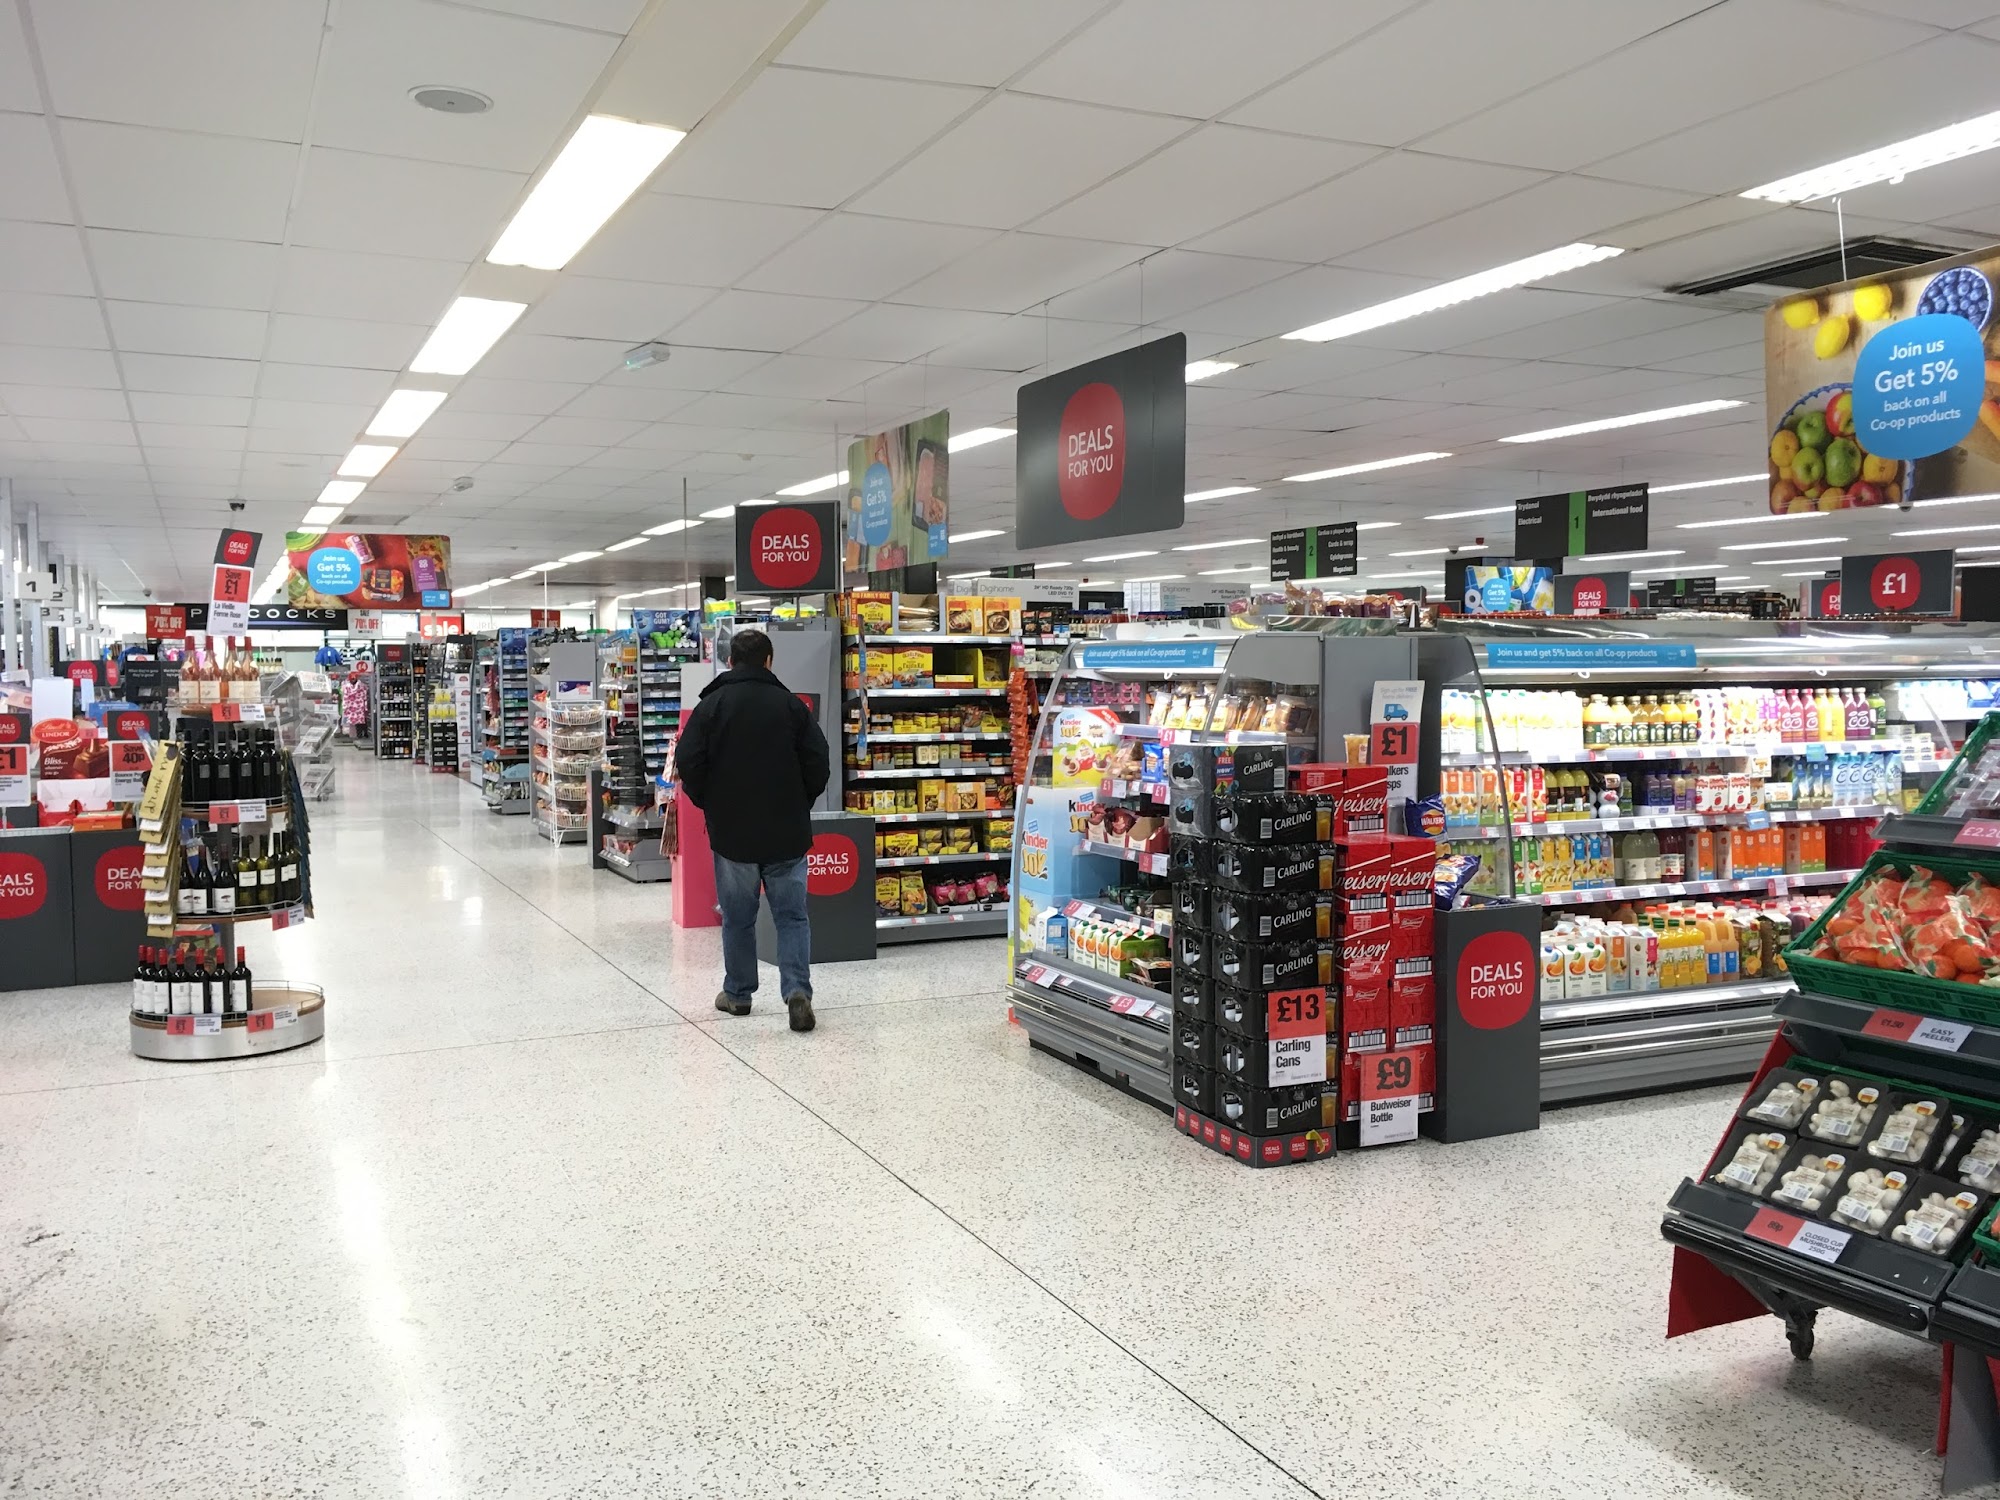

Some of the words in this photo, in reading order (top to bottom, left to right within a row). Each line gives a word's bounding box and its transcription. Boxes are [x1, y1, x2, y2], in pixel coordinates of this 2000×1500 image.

[1889, 343, 1922, 361] Join
[1927, 340, 1945, 354] us
[1875, 371, 1915, 393] Get
[1921, 359, 1959, 386] 5%
[1884, 397, 1912, 413] back
[1914, 398, 1930, 407] on
[1932, 391, 1947, 405] all
[1871, 417, 1905, 431] Co-op
[1908, 408, 1961, 427] products
[1068, 425, 1114, 458] DEALS
[1068, 460, 1088, 480] FOR
[1090, 454, 1114, 474] YOU
[867, 495, 877, 507] Get
[878, 492, 887, 503] 5%
[1518, 502, 1540, 511] Trydanol
[1592, 506, 1629, 518] International
[1629, 505, 1644, 514] food
[1518, 517, 1543, 526] Electrical
[1575, 516, 1580, 529] 1
[230, 541, 249, 550] DEALS
[762, 534, 810, 551] DEALS
[762, 552, 784, 563] FOR
[786, 551, 810, 563] YOU
[1309, 546, 1314, 557] 2
[317, 563, 335, 572] Get
[336, 563, 351, 572] 5%
[1333, 566, 1354, 574] Magazines
[225, 569, 242, 580] Save
[26, 581, 37, 593] 1
[225, 580, 238, 596] £1
[980, 585, 1015, 594] Digihome
[1162, 585, 1191, 593] Digihome
[1882, 573, 1907, 595] £1
[1578, 592, 1602, 600] DEALS
[42, 607, 51, 617] 3
[655, 612, 668, 620] GOT
[154, 616, 169, 628] 70%
[170, 616, 183, 629] OFF
[355, 618, 367, 629] 70%
[368, 618, 380, 630] OFF
[424, 621, 459, 637] sale
[1087, 650, 1095, 658] Join
[1102, 649, 1110, 657] and
[1118, 649, 1126, 657] 5%
[1126, 649, 1136, 657] back
[1150, 648, 1165, 658] Co-op
[1165, 648, 1187, 658] products
[1497, 648, 1513, 658] Join
[1524, 648, 1538, 657] and
[1539, 649, 1552, 659] get
[1553, 648, 1565, 658] 5%
[1566, 648, 1583, 658] back
[1584, 650, 1594, 658] on
[1595, 648, 1604, 658] all
[1605, 649, 1626, 659] Co-op
[1627, 648, 1658, 659] products
[1060, 718, 1082, 726] Kinder
[1164, 731, 1173, 742] £1
[1381, 727, 1408, 756] £1
[123, 744, 144, 753] Save
[1243, 759, 1274, 776] CARLING
[1103, 781, 1112, 791] £1
[1156, 789, 1165, 798] £1
[1274, 811, 1312, 831] CARLING
[1421, 815, 1446, 827] WALKERS
[807, 853, 849, 866] DEALS
[108, 868, 143, 881] DEA
[807, 867, 827, 876] FOR
[828, 866, 849, 876] YOU
[1277, 859, 1315, 880] CARLING
[7, 887, 35, 897] YOU
[108, 881, 132, 891] FOR
[1273, 907, 1312, 929] CARLING
[1276, 954, 1314, 976] CARLING
[1470, 961, 1523, 985] DEALS
[1470, 985, 1496, 1000] FOR
[1498, 982, 1523, 997] YOU
[1118, 998, 1131, 1008] £3
[1277, 993, 1320, 1023] £13
[1920, 1032, 1956, 1044] PEELERS
[1930, 1028, 1954, 1036] EASY
[1275, 1039, 1312, 1054] Carling
[1275, 1055, 1301, 1068] Cans
[1376, 1056, 1412, 1091] £9
[1280, 1098, 1318, 1120] CARLING
[1370, 1098, 1412, 1112] Budweiser
[1370, 1111, 1394, 1124] Bottle
[1221, 1134, 1231, 1142] DEALS
[1238, 1142, 1250, 1150] DEALS
[1799, 1236, 1842, 1254] MUSHROOMS
[1805, 1231, 1830, 1244] CLOSED
[1830, 1240, 1845, 1248] CUP
[1808, 1245, 1826, 1255] 250G
